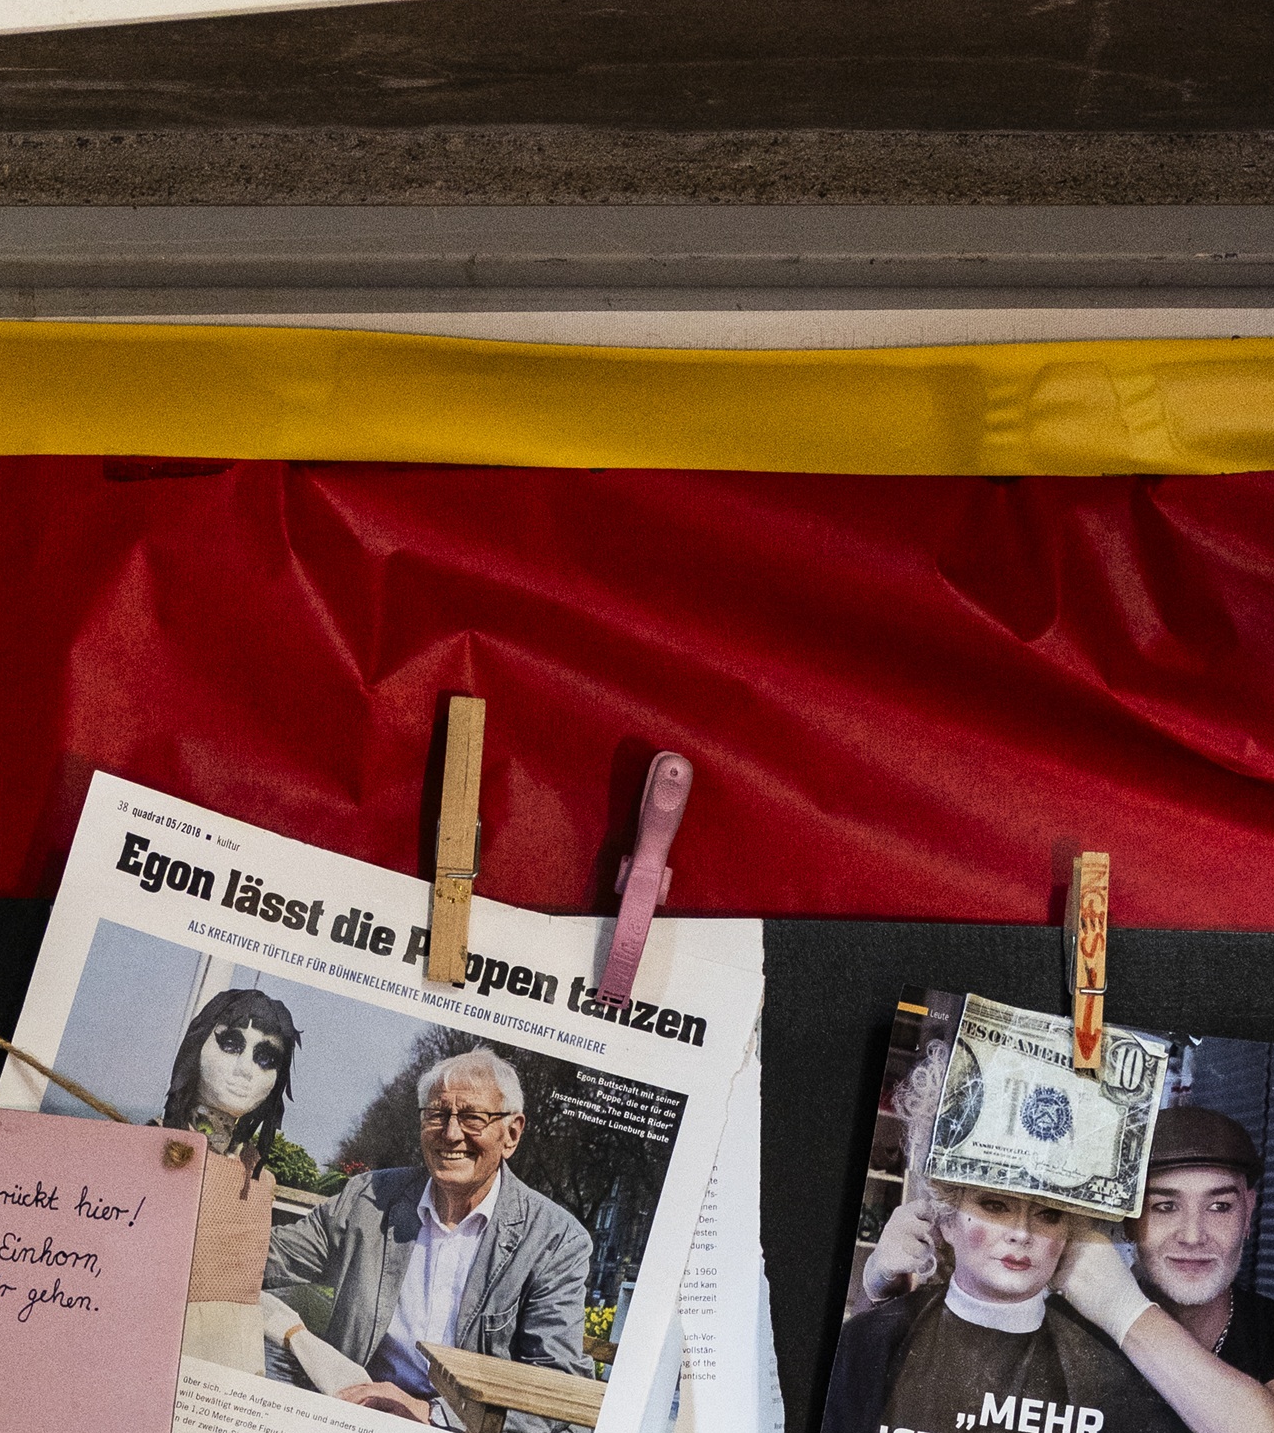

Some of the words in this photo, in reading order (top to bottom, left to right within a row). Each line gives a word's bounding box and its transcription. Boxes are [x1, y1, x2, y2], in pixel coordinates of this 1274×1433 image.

[116, 800, 129, 813] 38
[129, 804, 166, 828] quadrat
[163, 815, 203, 840] 05/2018
[215, 833, 242, 853] kultur
[116, 832, 215, 901] Egon
[222, 869, 325, 936] lässt
[330, 907, 396, 957] die
[403, 926, 559, 1005] Pppen
[186, 919, 207, 937] ALS
[206, 925, 261, 954] KREATIVER
[260, 940, 306, 967] TÜFTLER
[304, 953, 329, 974] FÜR
[327, 961, 421, 1002] BÜHNENELEMENTE
[420, 988, 464, 1015] MACHTE
[462, 1001, 492, 1023] EGON
[491, 1010, 556, 1043] BUTTSCHAFT
[555, 1029, 607, 1057] KARRIERE
[549, 1090, 602, 1113] Inszenierung
[601, 1105, 622, 1118] „The
[623, 1110, 646, 1123] Black
[646, 1117, 673, 1131] Rider“
[575, 1071, 598, 1084] Egon
[597, 1077, 639, 1095] Buttschaft
[639, 1089, 654, 1100] mit
[655, 1093, 680, 1106] seiner
[595, 1089, 625, 1106] Puppe,
[625, 1097, 639, 1109] die
[639, 1103, 649, 1112] er
[649, 1104, 662, 1115] für
[662, 1108, 676, 1119] die
[562, 1107, 575, 1117] am
[576, 1110, 607, 1126] Theater
[607, 1119, 645, 1138] Lüneburg
[646, 1130, 669, 1143] baute
[73, 1184, 146, 1228] hier!
[17, 1273, 102, 1331] gehen.
